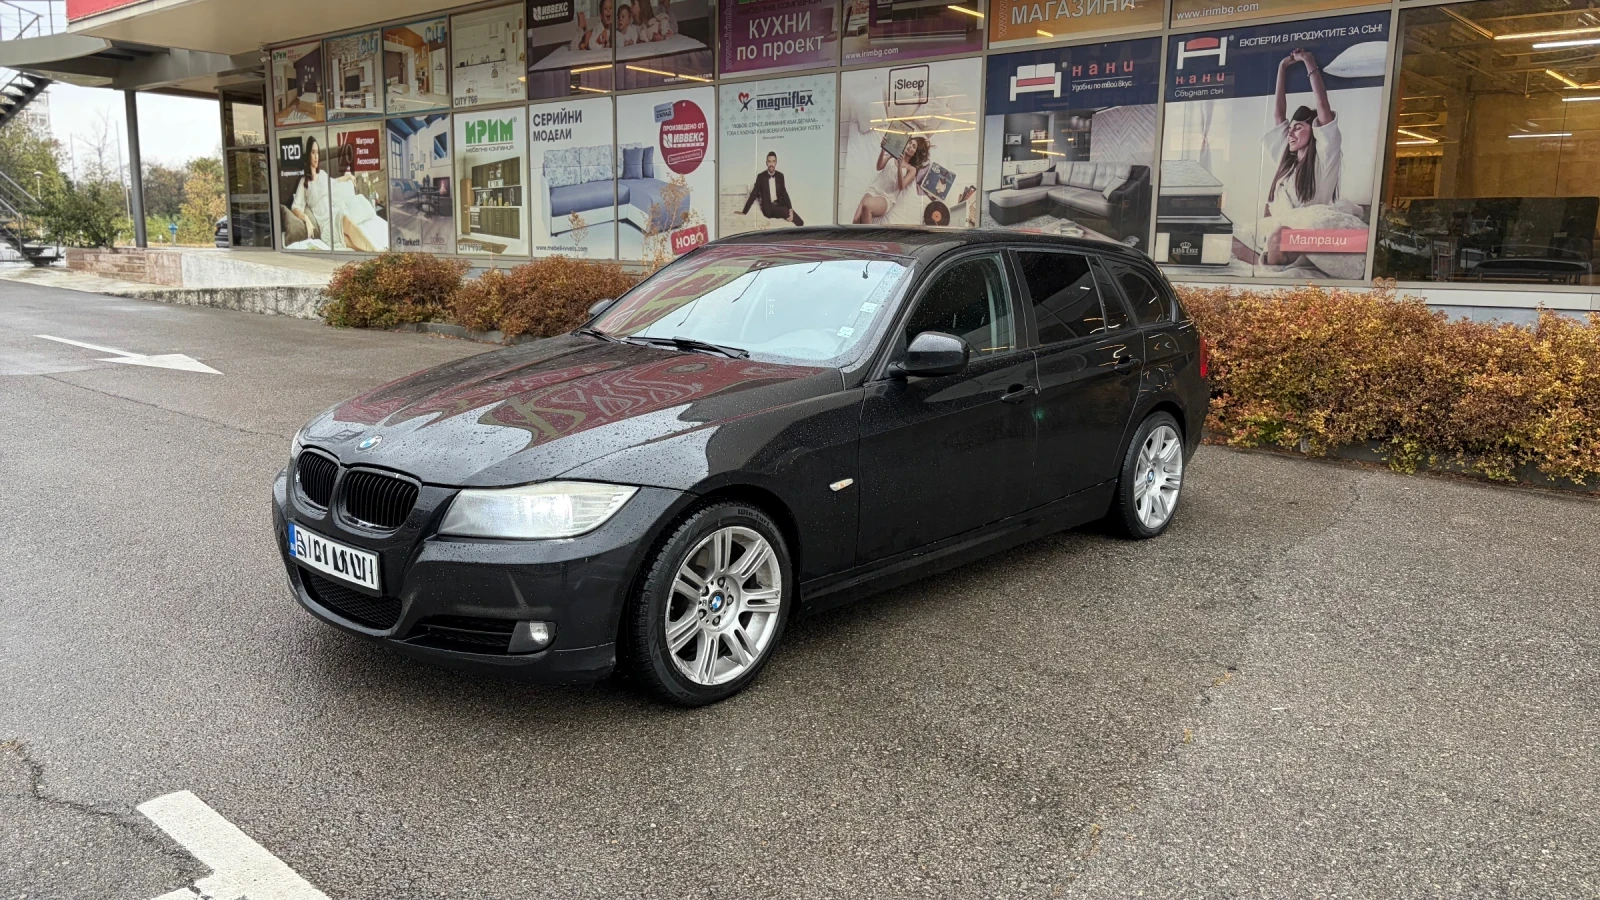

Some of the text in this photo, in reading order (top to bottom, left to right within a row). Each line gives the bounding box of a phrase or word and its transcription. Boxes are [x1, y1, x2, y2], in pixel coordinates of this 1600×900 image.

[542, 2, 568, 16] ИВВЕКС
[1176, 2, 1259, 20] www.irimbg.com
[749, 11, 811, 39] КУХНИ
[1239, 24, 1383, 47] ЕКСПЕРТИ В ПРОДУКТИТЕ ЗА СЪН!
[737, 35, 825, 60] по проект
[845, 47, 899, 59] www.irimbg.com
[1072, 60, 1134, 77] нани
[894, 79, 924, 90] iSleep
[1175, 72, 1225, 85] нани
[1071, 83, 1093, 92] Удобни
[1101, 81, 1118, 89] твой
[1117, 80, 1133, 88] вкус
[1174, 89, 1209, 98] Сбъднат
[455, 97, 468, 106] CITY
[756, 91, 815, 111] magniflex
[533, 107, 583, 127] СЕРИЙНИ
[465, 118, 514, 144] ИРИМ
[663, 123, 697, 132] ПРОИЗВЕДЕНО
[355, 137, 375, 146] Матраци
[533, 128, 572, 142] МОДЕЛИ
[673, 132, 704, 143] ИВВЕКС
[356, 158, 379, 166] Аксесоари
[402, 238, 420, 247] Tarkett
[675, 231, 704, 249] НОВО
[1289, 234, 1347, 246] Матраци
